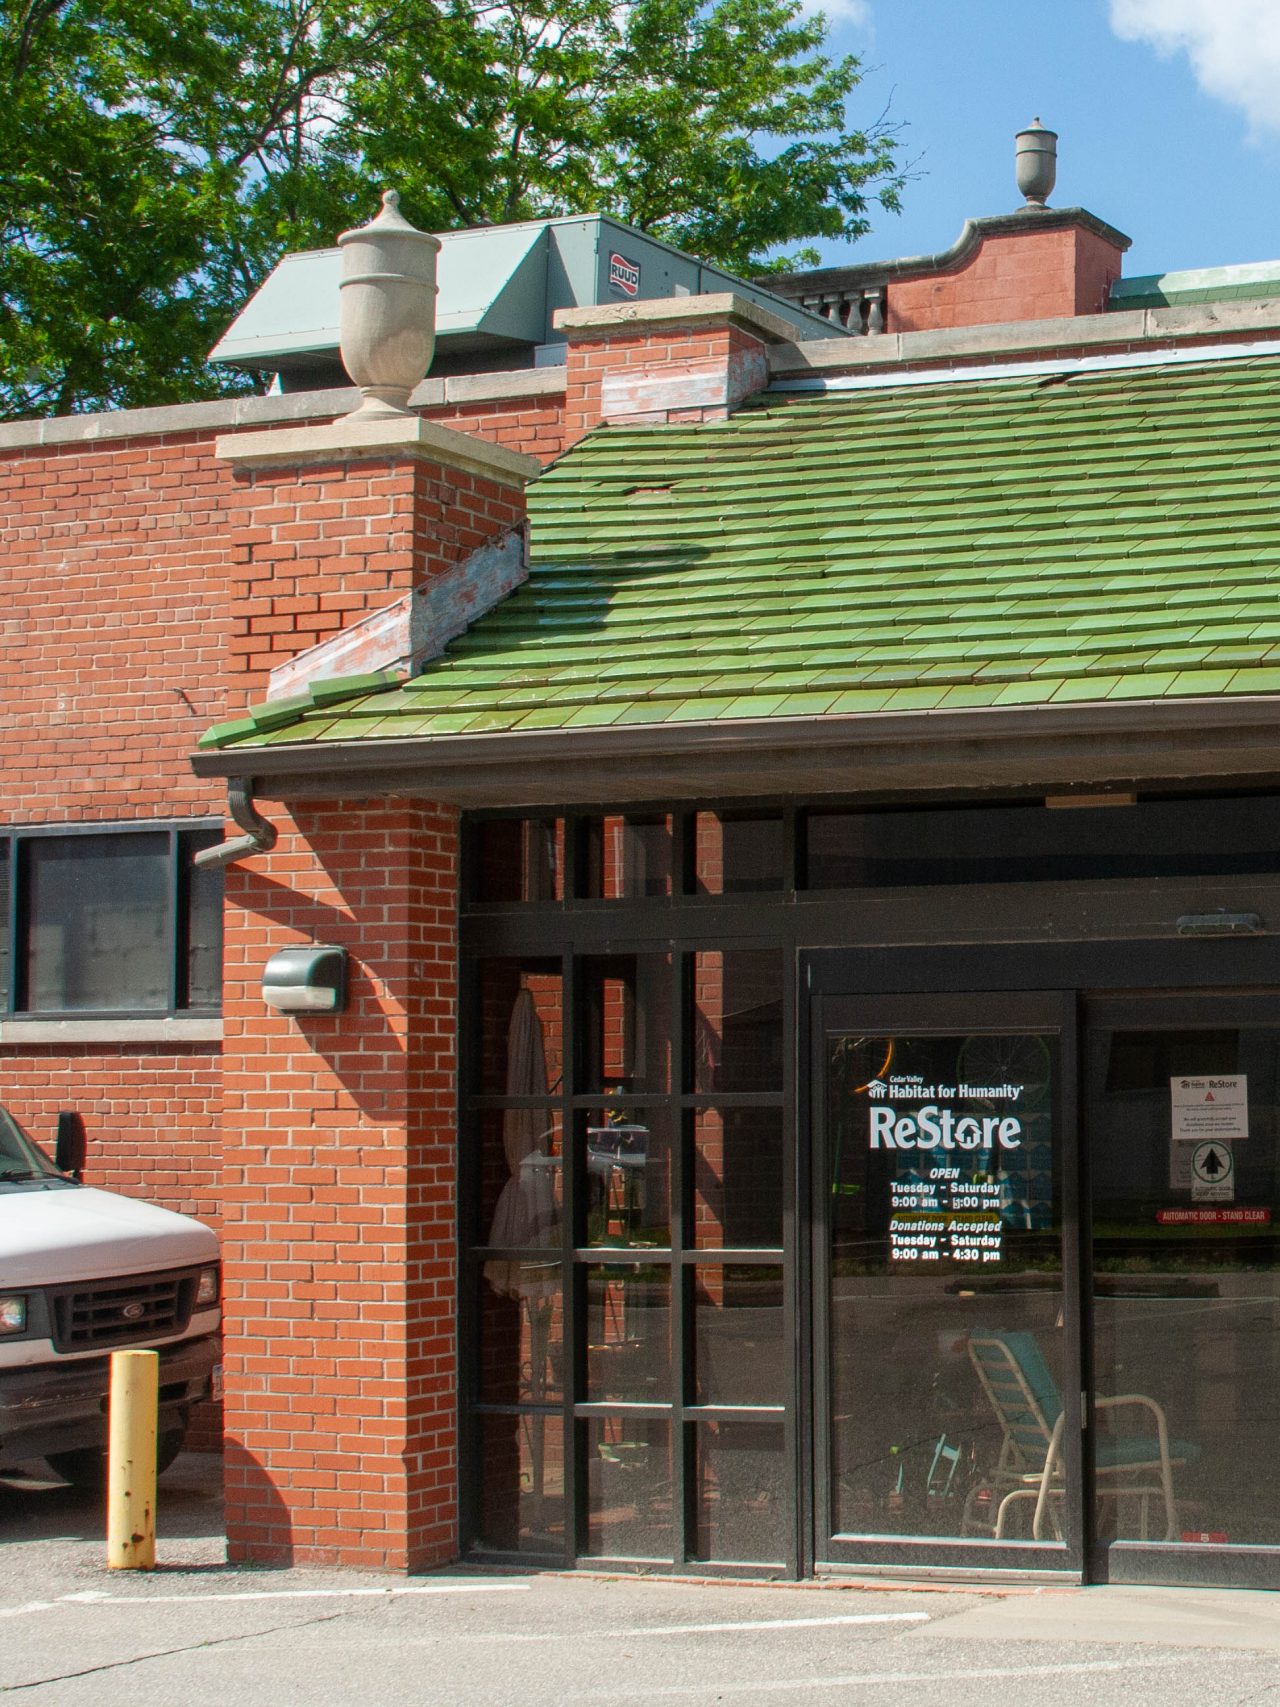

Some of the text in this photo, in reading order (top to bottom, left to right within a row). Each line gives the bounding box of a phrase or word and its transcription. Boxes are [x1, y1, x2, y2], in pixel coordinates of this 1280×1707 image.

[612, 264, 638, 285] RUUD
[889, 1075, 924, 1084] Cedar Valley
[1209, 1080, 1238, 1089] ReStore
[889, 1083, 1020, 1100] Habitat for Humanity
[869, 1105, 1022, 1149] ReStore
[929, 1167, 960, 1179] OPEN
[890, 1182, 936, 1194] Tuesday
[950, 1182, 1000, 1194] Saturday
[891, 1197, 917, 1207] 9:00
[921, 1199, 938, 1207] am
[982, 1199, 1000, 1209] pm
[1162, 1211, 1198, 1220] AUTOMATIC
[1200, 1211, 1217, 1220] DOOR
[1222, 1211, 1243, 1220] STAND
[1244, 1210, 1265, 1220] CLEAR
[889, 1220, 1002, 1233] Donations Accepted
[890, 1234, 936, 1247] Tuesday
[951, 1234, 1001, 1247] Saturday
[892, 1248, 918, 1260] 9:00
[922, 1250, 939, 1260] am
[953, 1248, 979, 1260] 4:30
[983, 1250, 1000, 1262] pm
